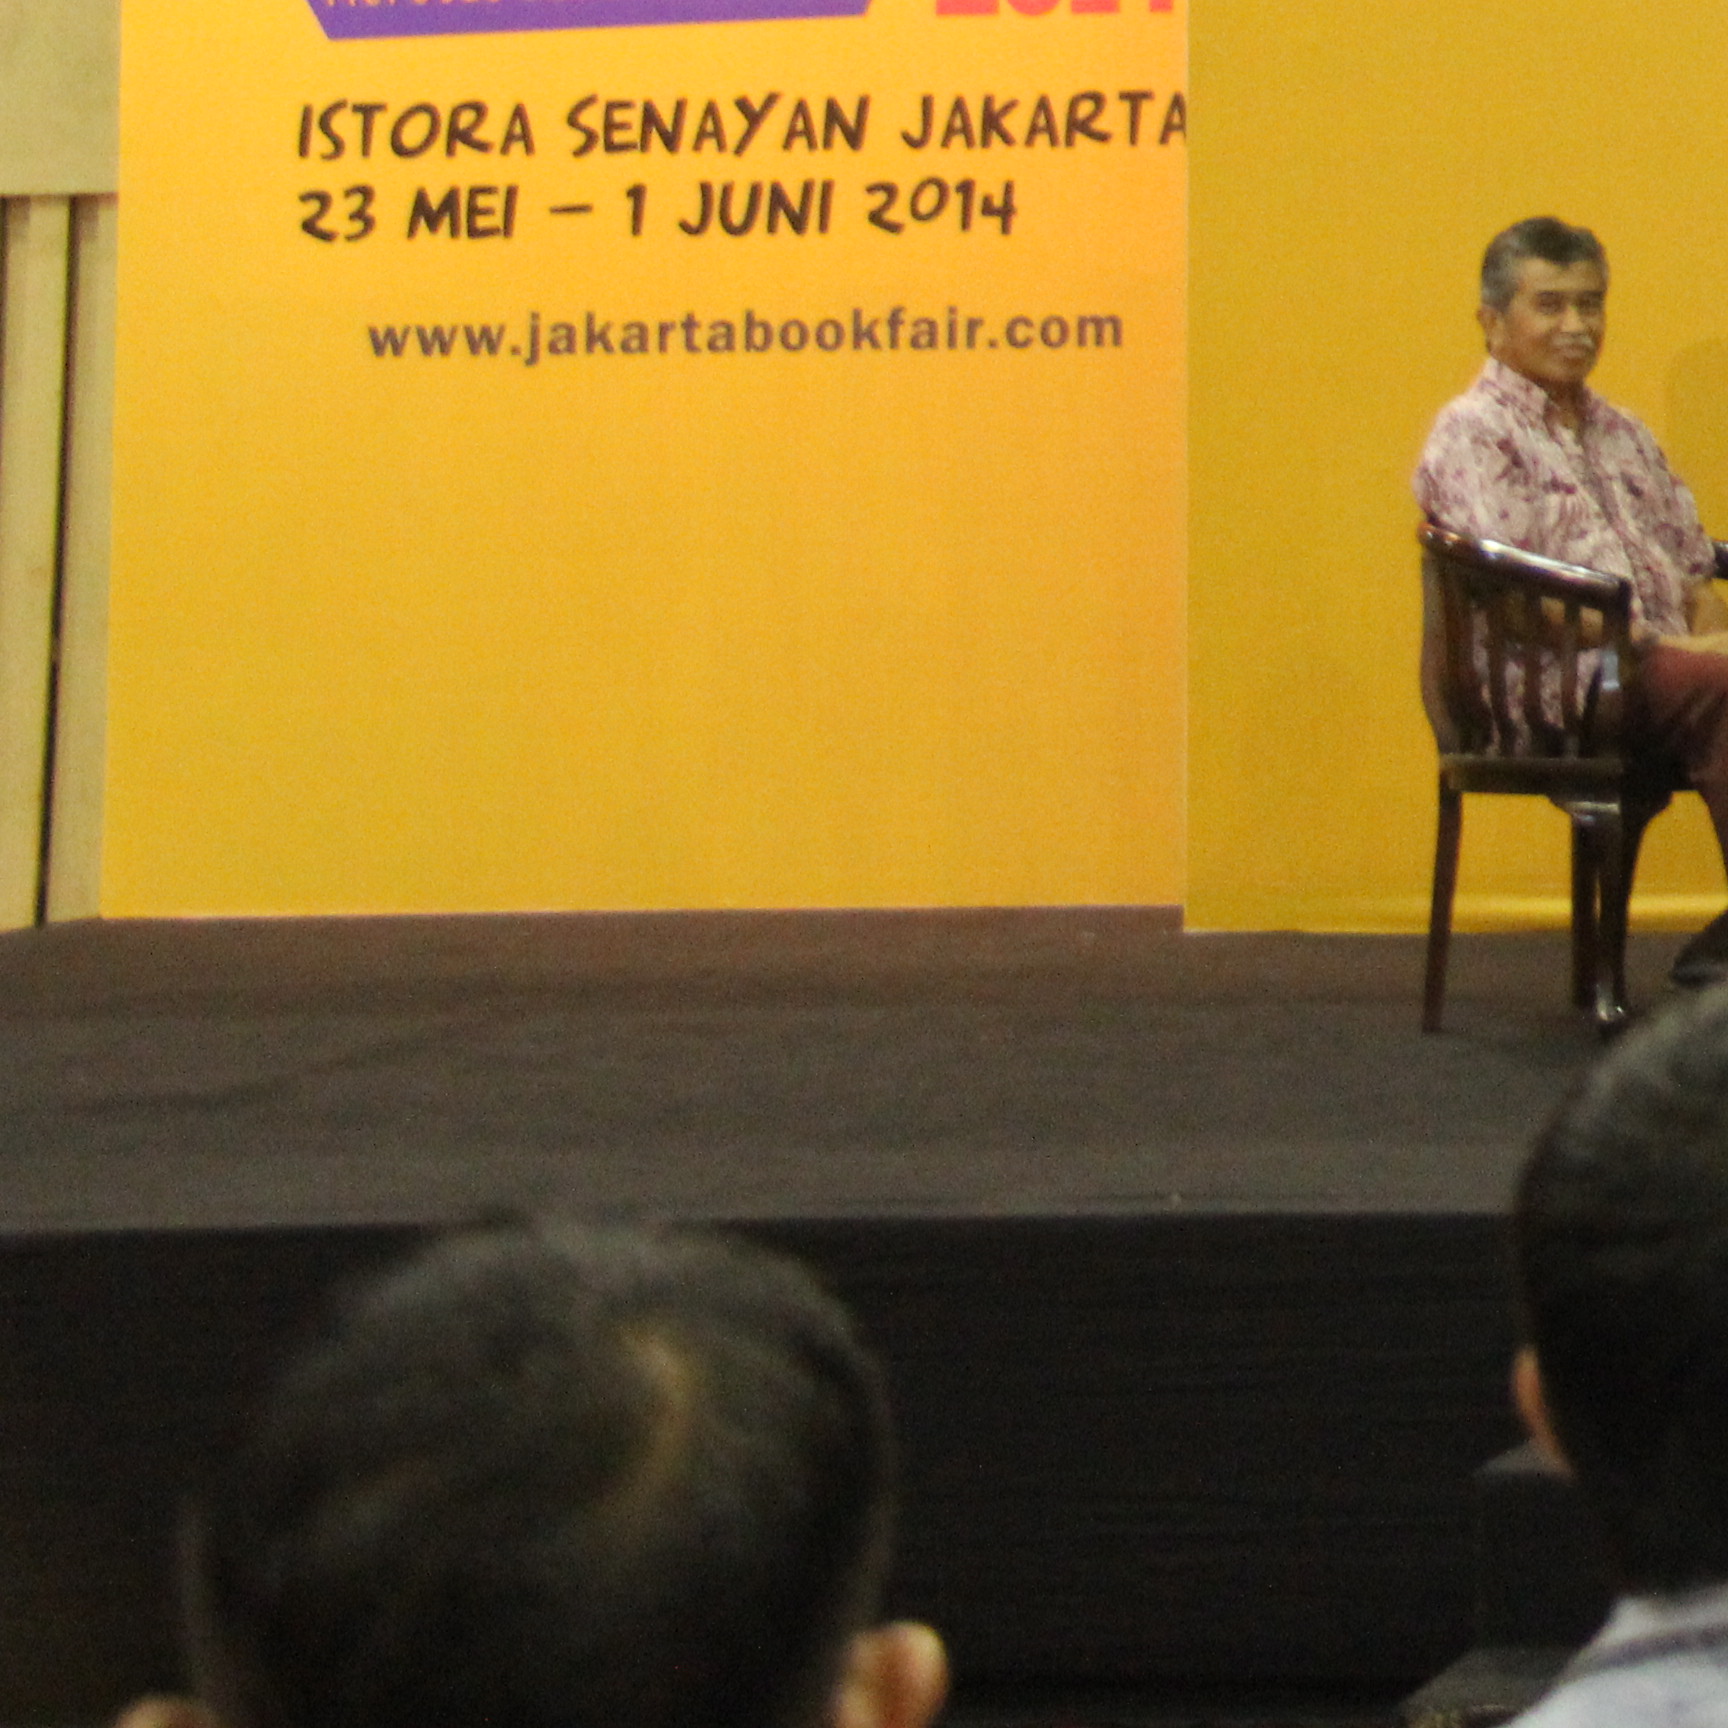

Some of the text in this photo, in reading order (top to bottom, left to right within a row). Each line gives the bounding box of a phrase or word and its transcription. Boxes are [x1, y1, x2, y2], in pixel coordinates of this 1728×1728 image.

[298, 90, 1187, 159] ISTORA SENAYAN JAKARTA
[298, 186, 375, 241] 23
[407, 183, 519, 240] MEI
[627, 184, 644, 236] 1
[680, 179, 833, 236] JUNI
[866, 178, 1016, 236] 2014
[368, 307, 1124, 365] www.jakartabookfair.com
